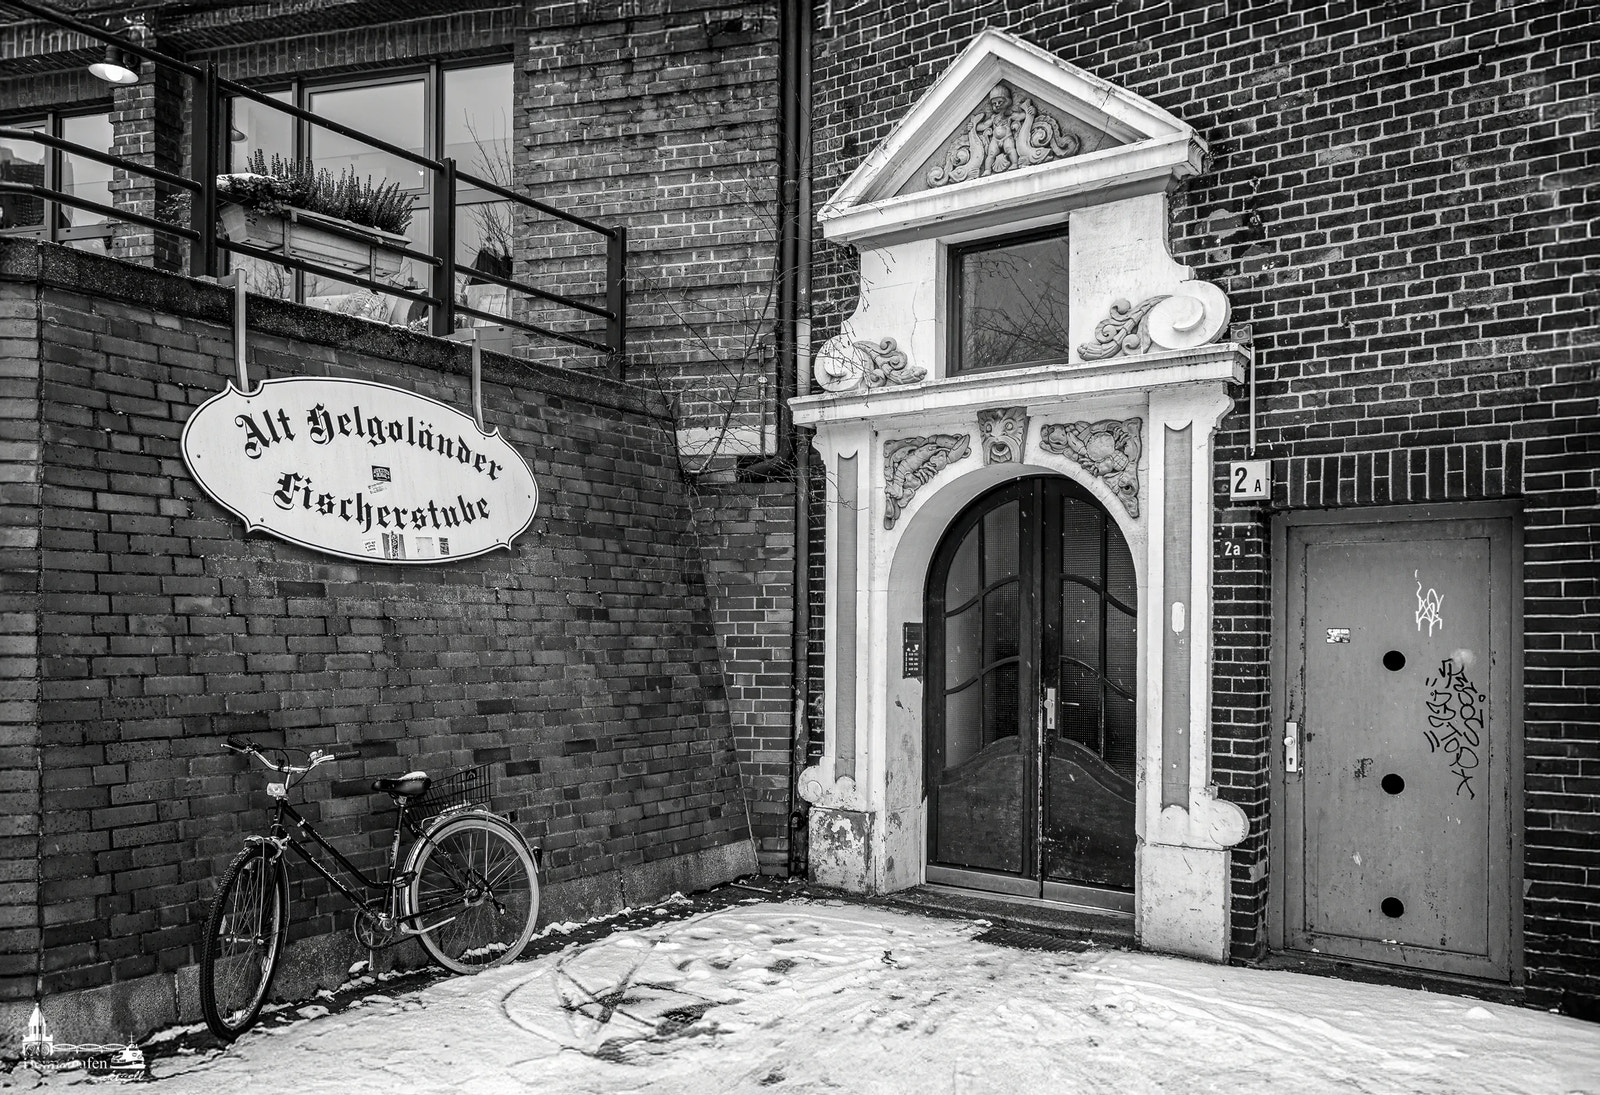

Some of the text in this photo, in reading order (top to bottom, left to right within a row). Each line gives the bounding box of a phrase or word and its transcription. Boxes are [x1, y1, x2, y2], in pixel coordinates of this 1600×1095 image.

[234, 403, 504, 480] Alt Helgoländer
[1234, 467, 1262, 493] 2 A
[272, 471, 491, 534] Fischerstube
[1224, 541, 1241, 556] 2a
